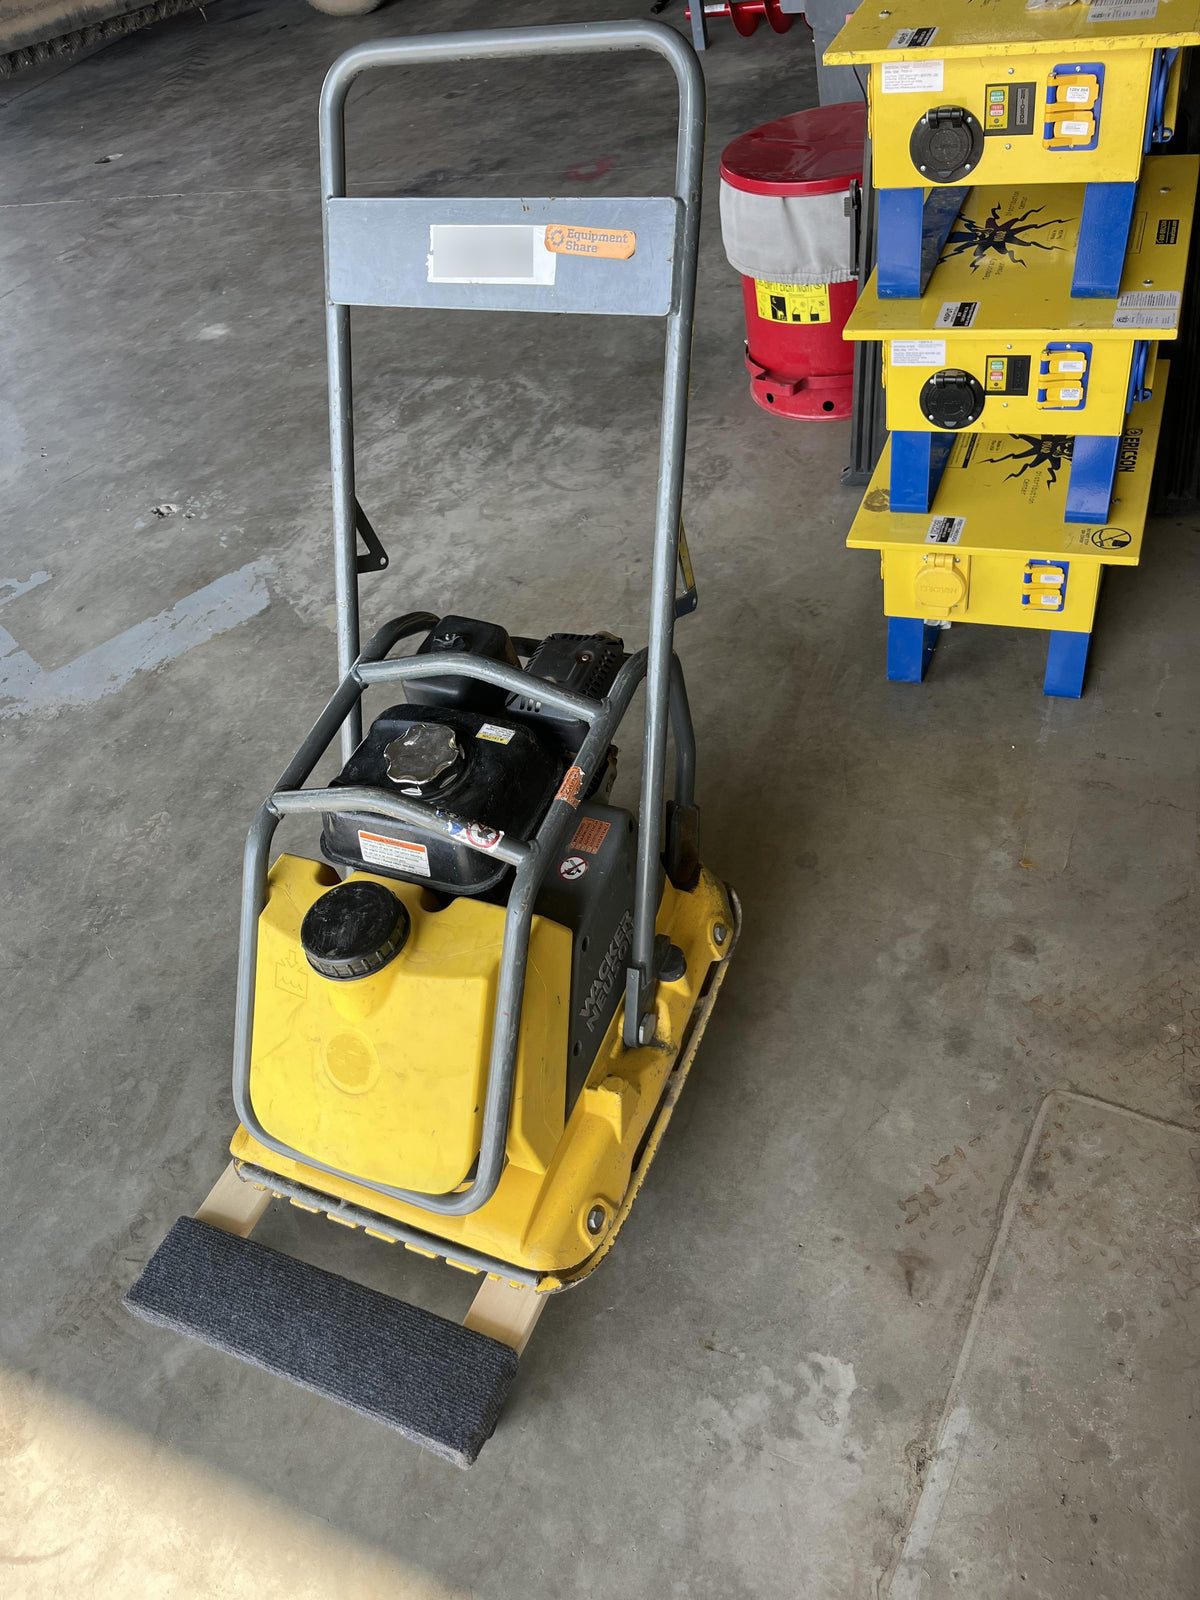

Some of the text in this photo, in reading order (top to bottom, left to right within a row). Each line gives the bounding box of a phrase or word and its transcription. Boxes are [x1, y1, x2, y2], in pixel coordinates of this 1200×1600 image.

[566, 240, 598, 253] Share
[567, 228, 628, 243] Equipment
[1118, 436, 1141, 473] ERICSON
[579, 909, 634, 1018] WACKER
